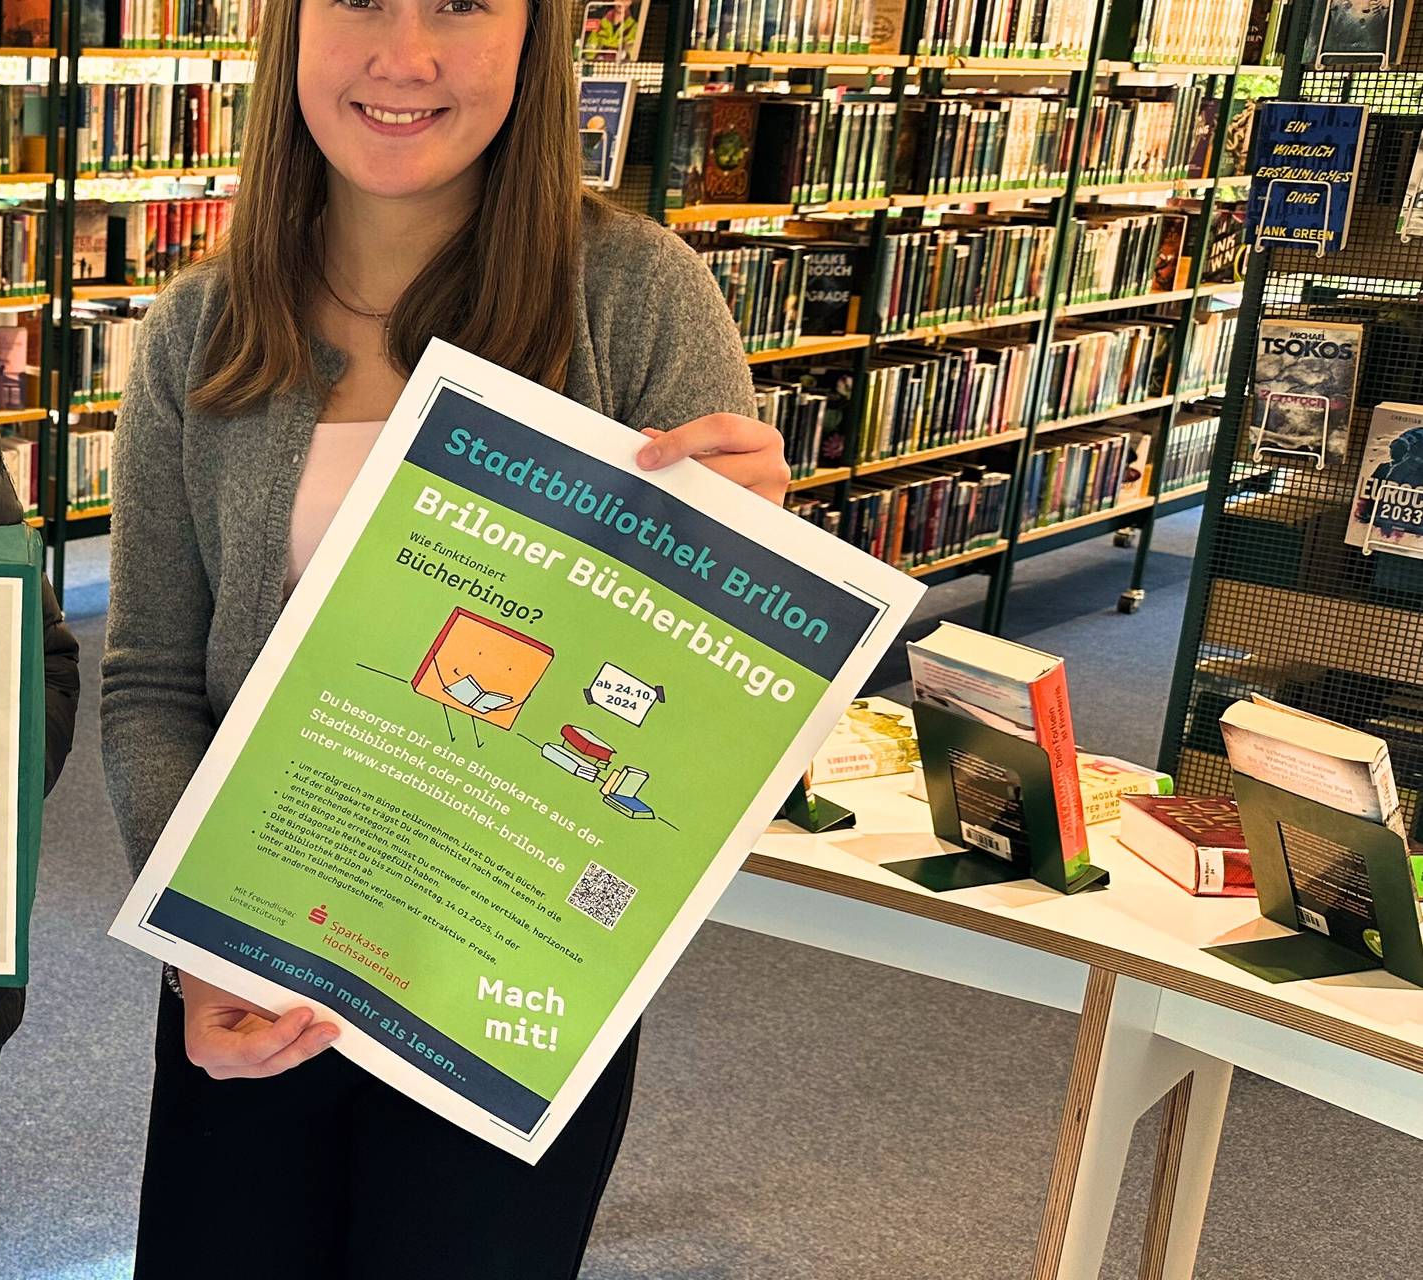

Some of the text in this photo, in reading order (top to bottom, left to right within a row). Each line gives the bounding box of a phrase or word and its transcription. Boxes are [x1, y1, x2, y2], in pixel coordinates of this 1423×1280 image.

[1256, 166, 1352, 183] ERSTAUNLICHES
[1273, 144, 1335, 158] WIRKLICH
[1293, 228, 1334, 241] GREEN
[1262, 337, 1353, 360] TSOKOS
[1289, 331, 1326, 341] MICHAEL
[444, 427, 828, 644] Stadtbibliothek Brilon
[1380, 504, 1422, 524] 2033
[409, 530, 507, 582] Wie funktioniert
[395, 546, 543, 624] Bücherbingo?
[412, 485, 795, 702] Briloner Bücherbingo
[595, 679, 660, 704] ab 24.10.
[604, 693, 637, 710] 2024
[309, 707, 510, 815] Stadtbibliothek oder online
[1049, 707, 1064, 769] Dein Fortsein
[318, 689, 604, 847] Du besorgst Dir eine Bingokarte aus der
[289, 784, 352, 816] entsprechende
[352, 811, 395, 836] Kategorie
[297, 761, 312, 772] Um
[312, 769, 361, 795] erfolgreich
[360, 790, 374, 801] am
[374, 796, 401, 813] Bingo
[401, 809, 460, 847] teilzunehmen,
[460, 841, 484, 860] liest
[482, 855, 496, 867] Du
[495, 864, 514, 879] drei
[299, 726, 565, 873] unter www.stadtbibliothek-brilon.de
[291, 771, 561, 922] Auf der Bingokarte trägst Du den Buchtitel nach dem Lesen in die
[233, 885, 296, 918] Mit freundlicher
[258, 831, 283, 847] Unter
[283, 843, 306, 858] allen
[306, 852, 369, 887] Teilnehmenden
[370, 883, 406, 908] verlosen
[406, 904, 422, 916] wir
[421, 913, 466, 944] attraktive
[321, 933, 410, 990] Hochsauerland
[329, 920, 389, 959] Sparkasse
[269, 956, 334, 992] machen
[336, 987, 380, 1019] mehr
[379, 1017, 406, 1040] als
[406, 1031, 466, 1082] lesen...
[477, 975, 564, 1016] Mach
[484, 1016, 558, 1052] mit!
